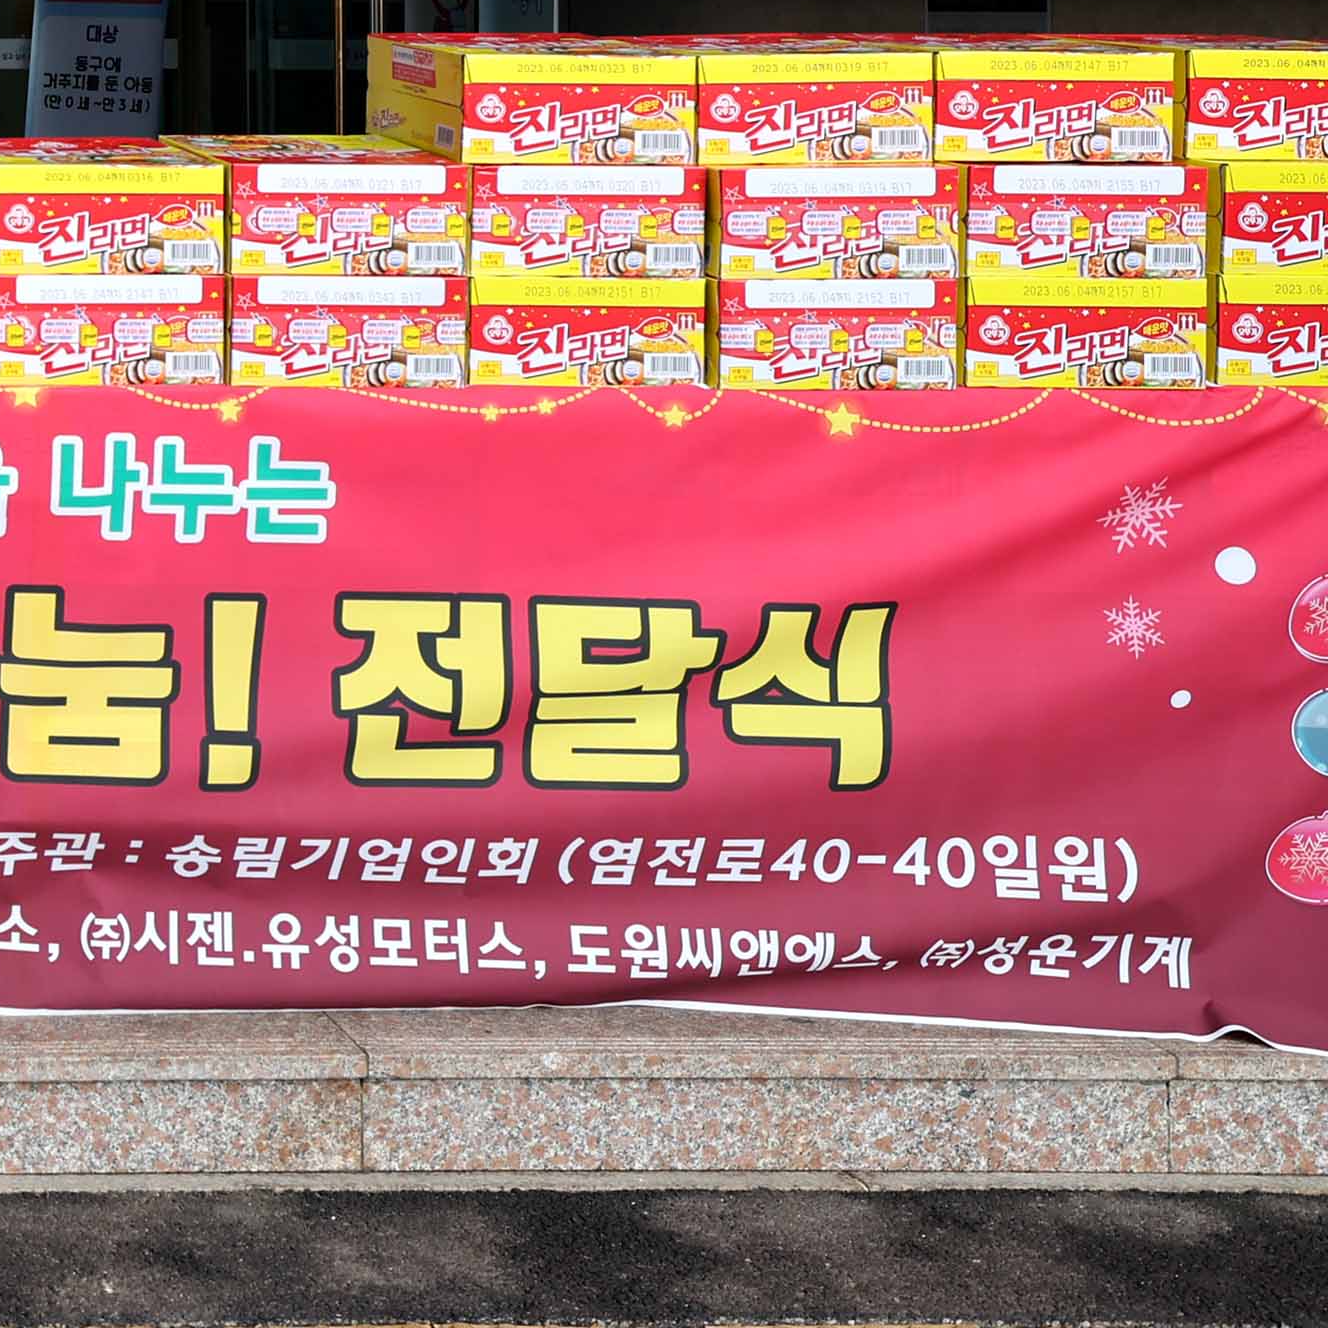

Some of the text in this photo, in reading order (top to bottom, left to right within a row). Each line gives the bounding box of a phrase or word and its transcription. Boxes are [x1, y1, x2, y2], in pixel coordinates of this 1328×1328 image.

[86, 24, 119, 44] 대상
[509, 102, 623, 157] 진라면
[982, 96, 1098, 155] 진라면
[38, 210, 149, 269] 진라면
[1014, 322, 1130, 379] 진라면
[51, 431, 336, 544] 나누는
[331, 591, 900, 791] 전달식
[163, 832, 541, 885] 송림기업인회
[557, 834, 1140, 904] (염전로40-40일원)
[567, 923, 900, 979] 도원씨앤에스,
